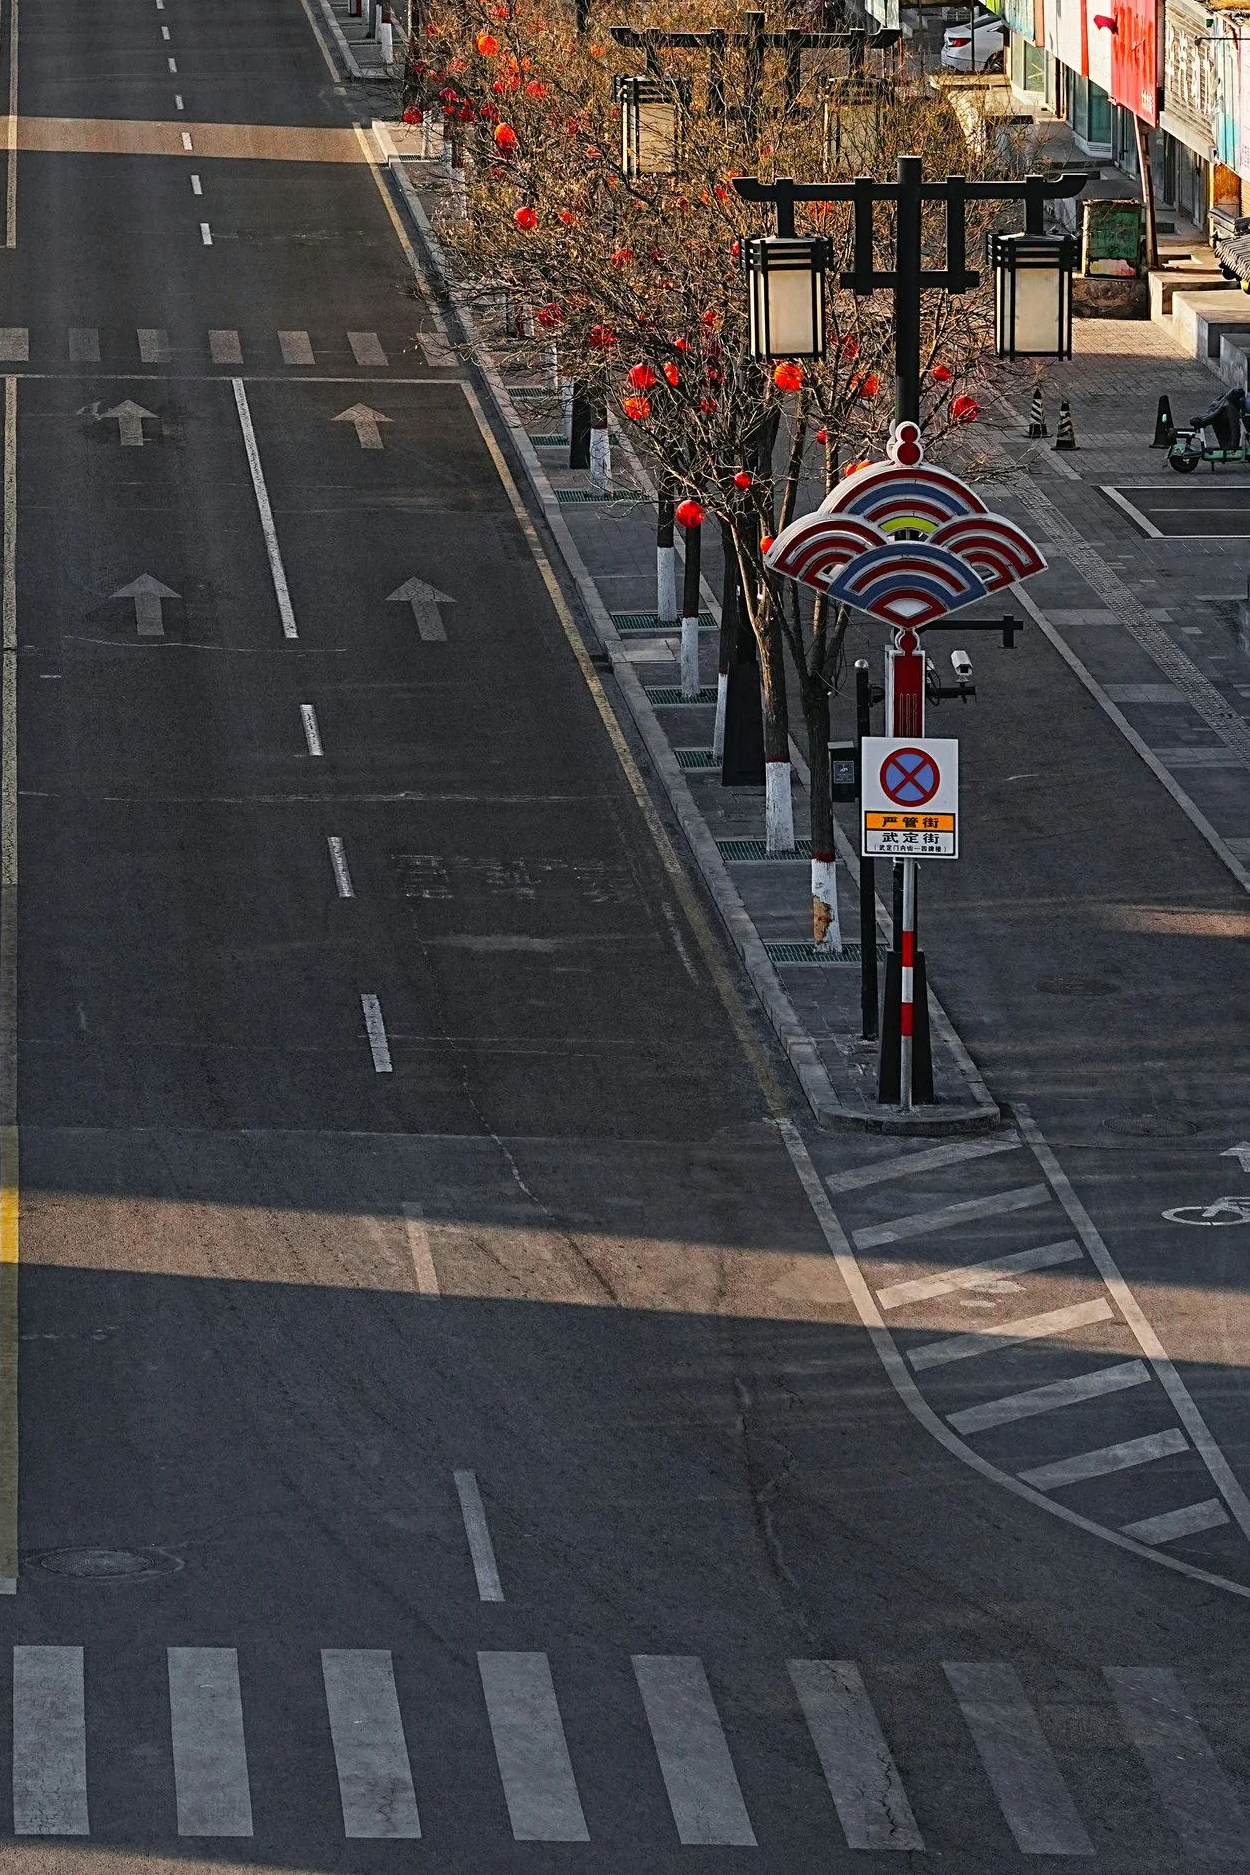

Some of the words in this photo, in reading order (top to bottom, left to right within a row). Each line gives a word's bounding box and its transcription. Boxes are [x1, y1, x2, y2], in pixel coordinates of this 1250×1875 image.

[882, 816, 939, 828] 严管街
[882, 832, 940, 844] 武定街
